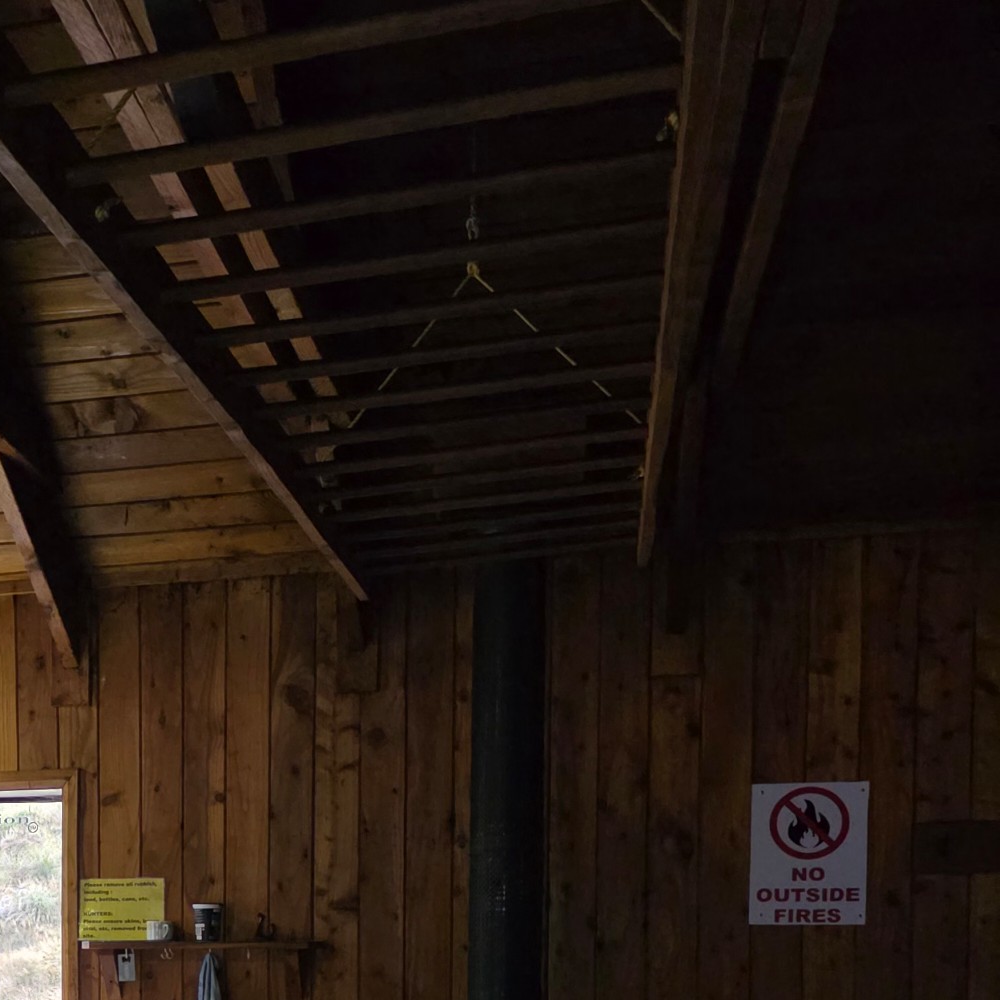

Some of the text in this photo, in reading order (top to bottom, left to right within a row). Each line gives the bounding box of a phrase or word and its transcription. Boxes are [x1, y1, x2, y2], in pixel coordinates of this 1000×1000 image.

[791, 867, 825, 881] NO
[756, 887, 860, 902] OUTSIDE
[774, 908, 841, 923] FIRES
